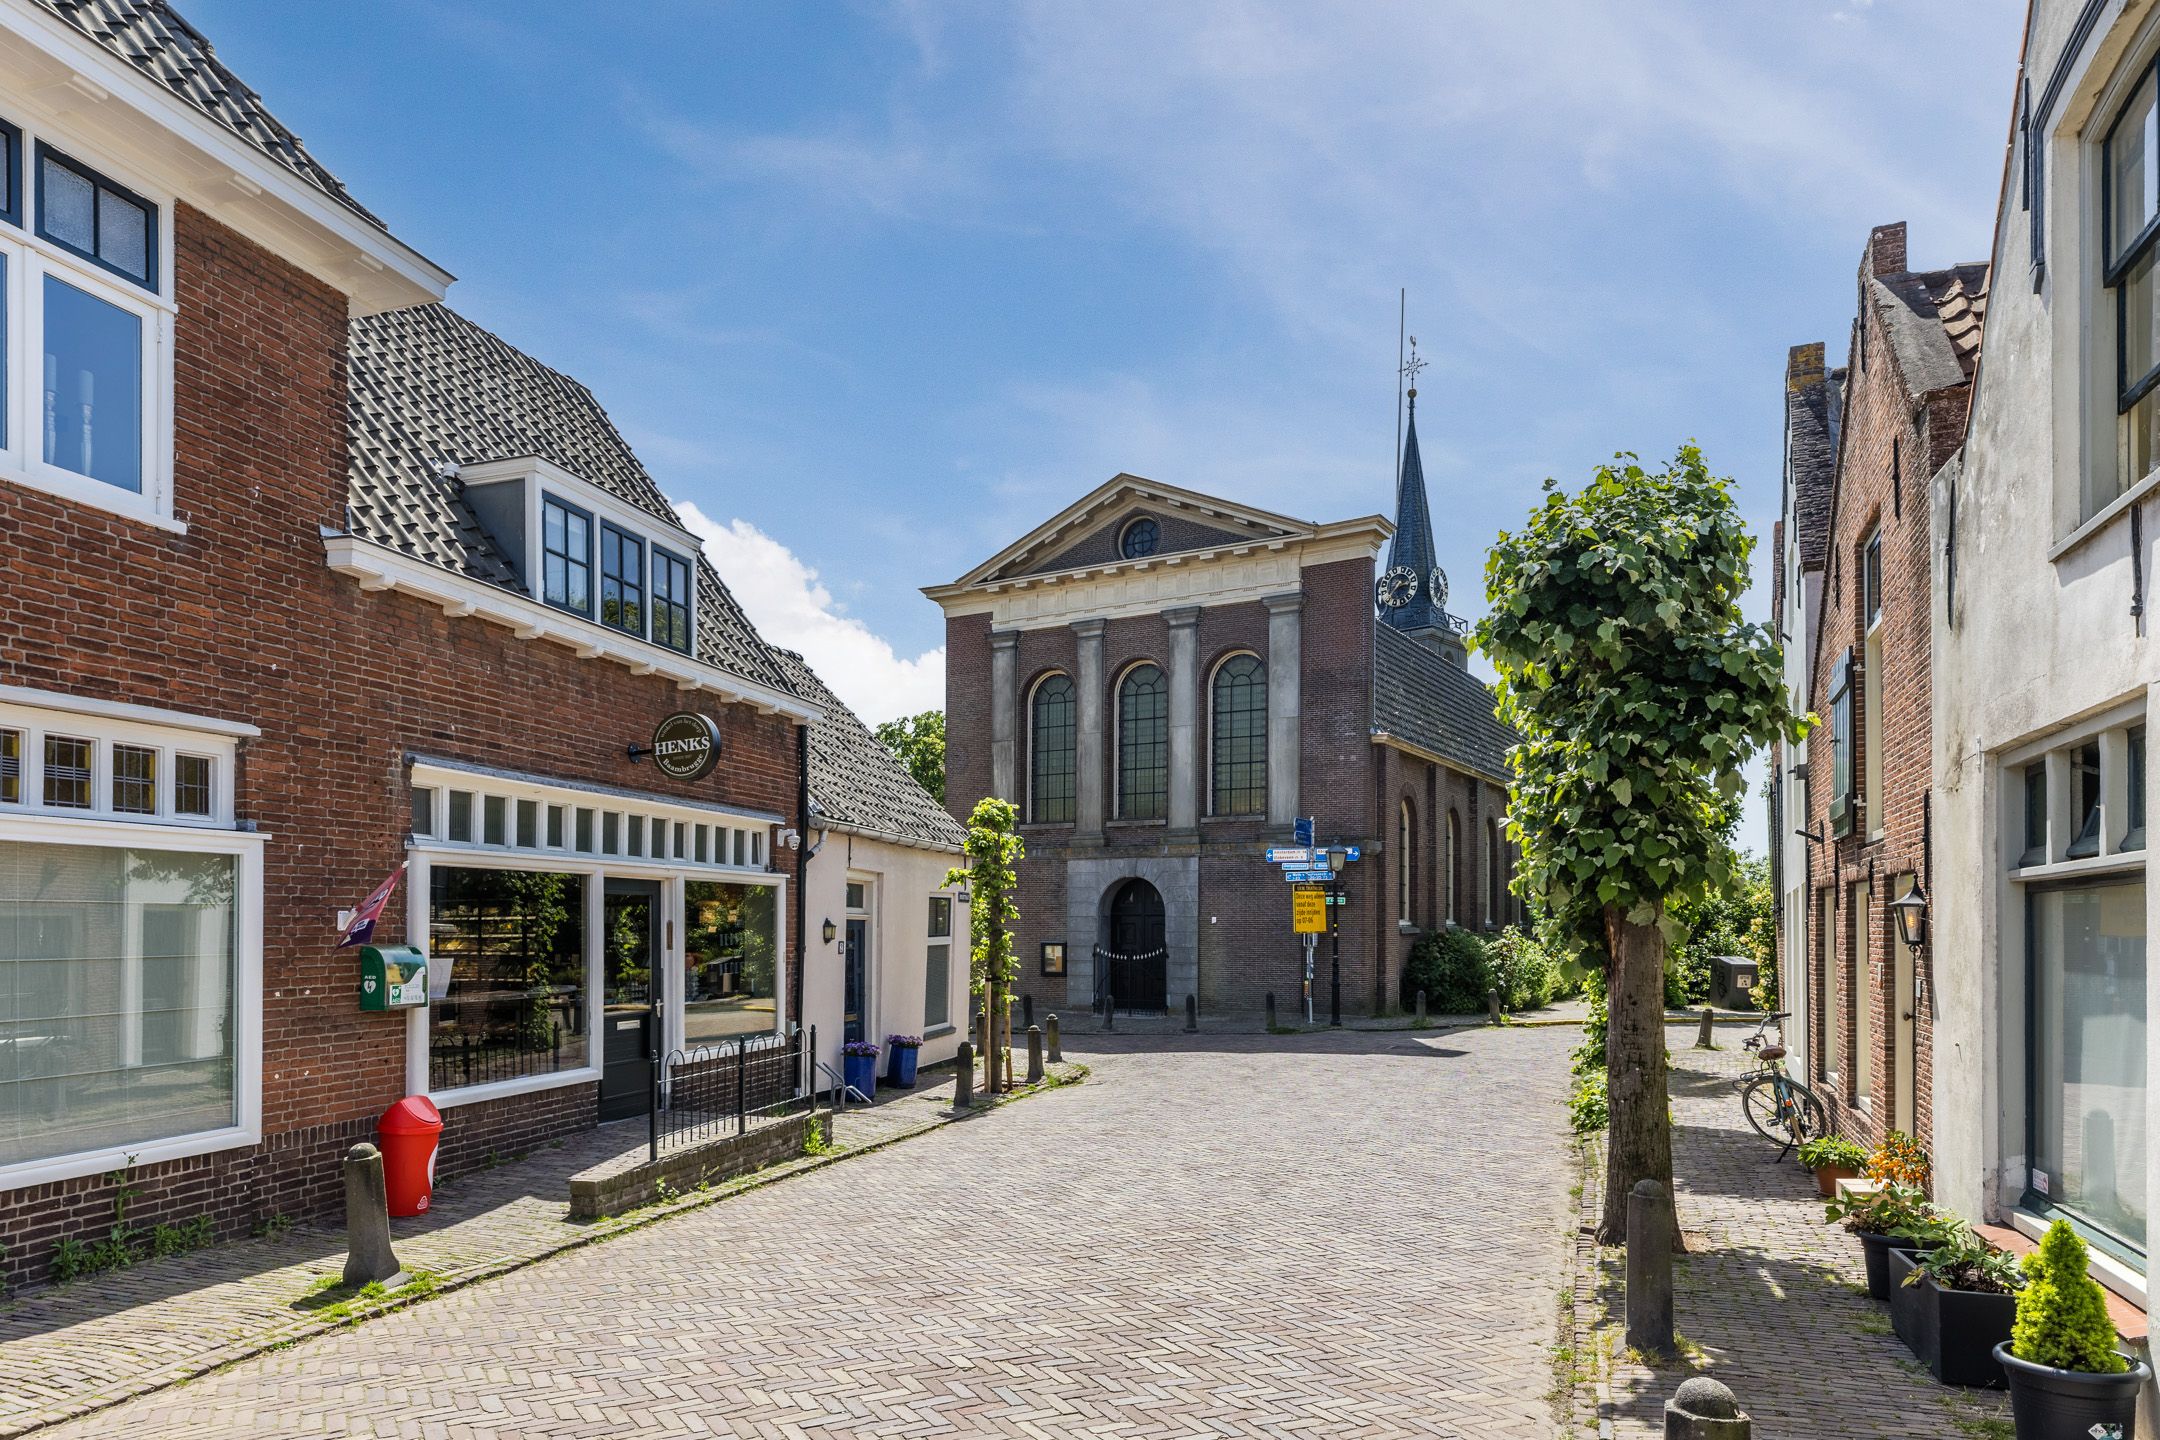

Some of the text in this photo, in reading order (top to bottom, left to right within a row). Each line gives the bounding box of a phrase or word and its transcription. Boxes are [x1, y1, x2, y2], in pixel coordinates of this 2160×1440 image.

[654, 736, 710, 755] HENKS
[663, 754, 703, 772] Baambrugge
[1296, 909, 1306, 917] zijde
